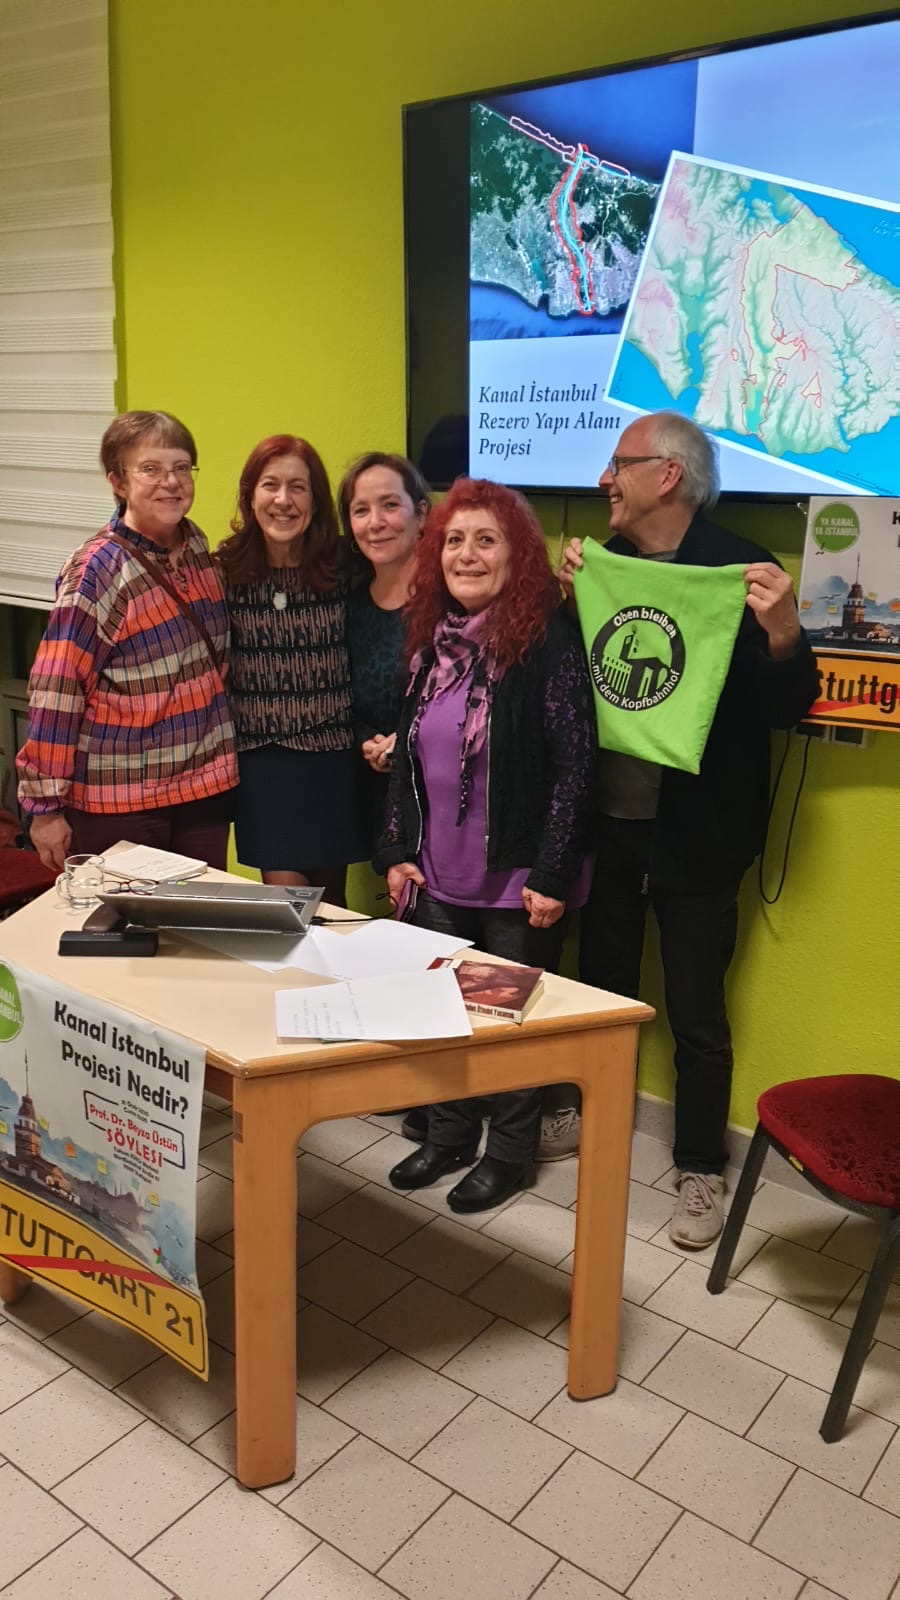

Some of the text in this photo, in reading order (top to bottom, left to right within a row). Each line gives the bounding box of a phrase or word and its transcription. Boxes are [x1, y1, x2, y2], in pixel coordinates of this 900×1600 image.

[478, 380, 598, 403] Kanal İstanbul
[478, 411, 621, 435] Rezerv Yapı Alanı
[478, 438, 532, 461] Projesi
[613, 607, 677, 639] Oben bleiben
[600, 684, 620, 704] dem
[621, 668, 681, 711] Kopfbahnhof
[815, 668, 900, 714] Stuttg
[54, 1000, 107, 1045] Kanal
[61, 1039, 189, 1120] Projesi Nedir?
[89, 1103, 110, 1121] Prof.
[110, 1112, 126, 1128] Dr.
[0, 1202, 156, 1317] TUTTGART
[164, 1301, 195, 1347] 21
